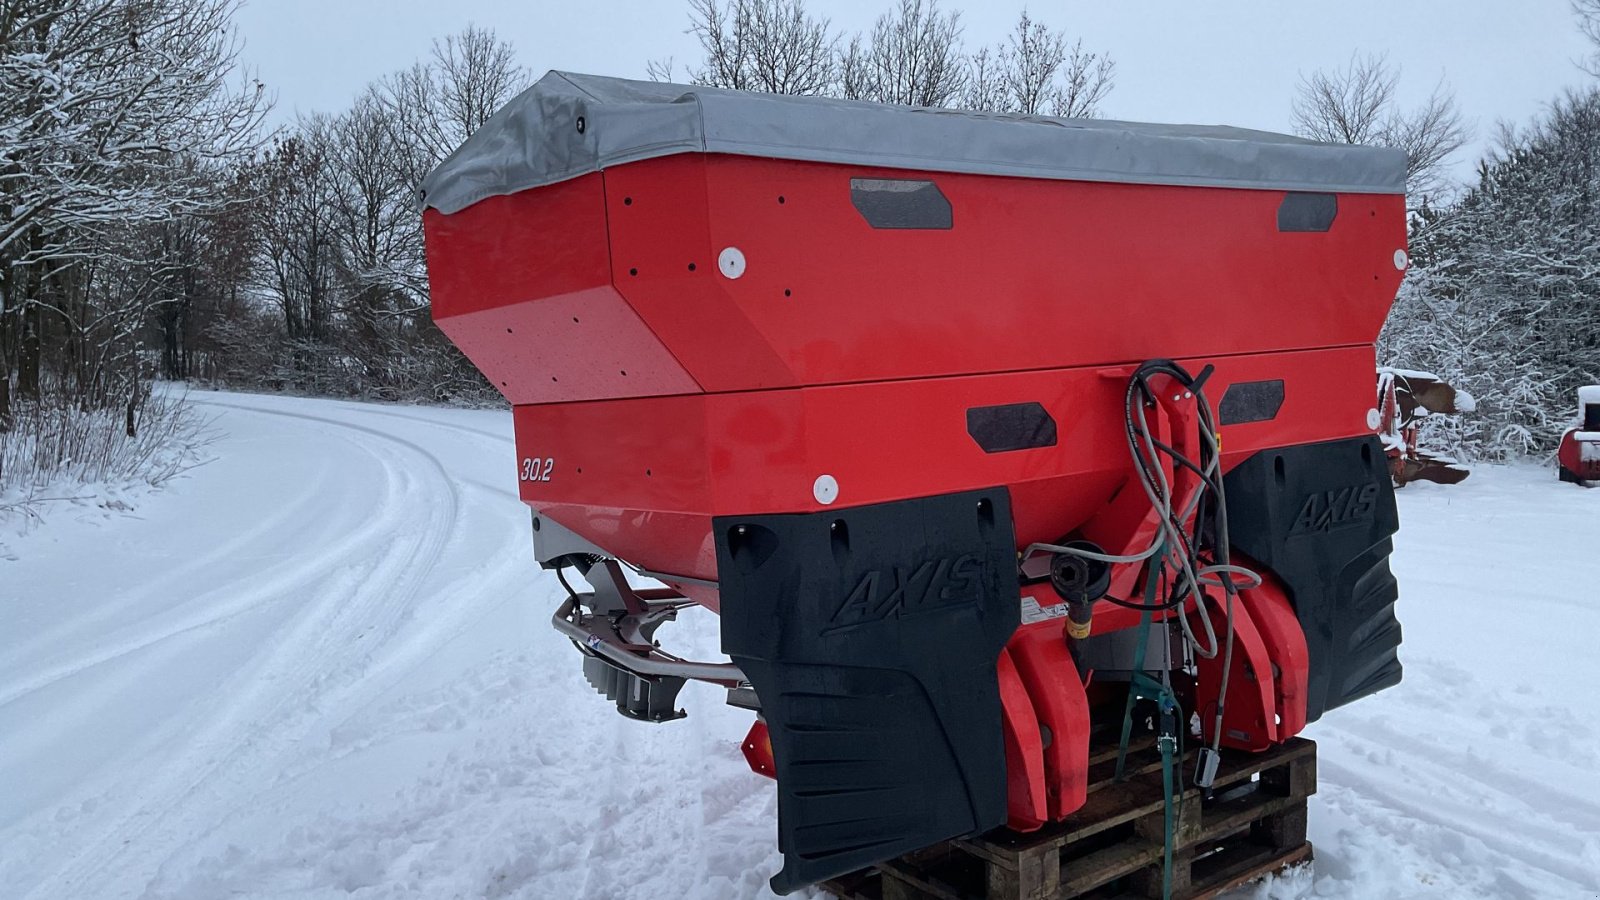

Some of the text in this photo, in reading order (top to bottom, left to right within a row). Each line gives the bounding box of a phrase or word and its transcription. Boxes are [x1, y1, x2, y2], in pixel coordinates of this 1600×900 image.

[520, 457, 554, 481] 30.2
[1287, 481, 1380, 533] AXIS
[829, 553, 984, 623] AXIS
